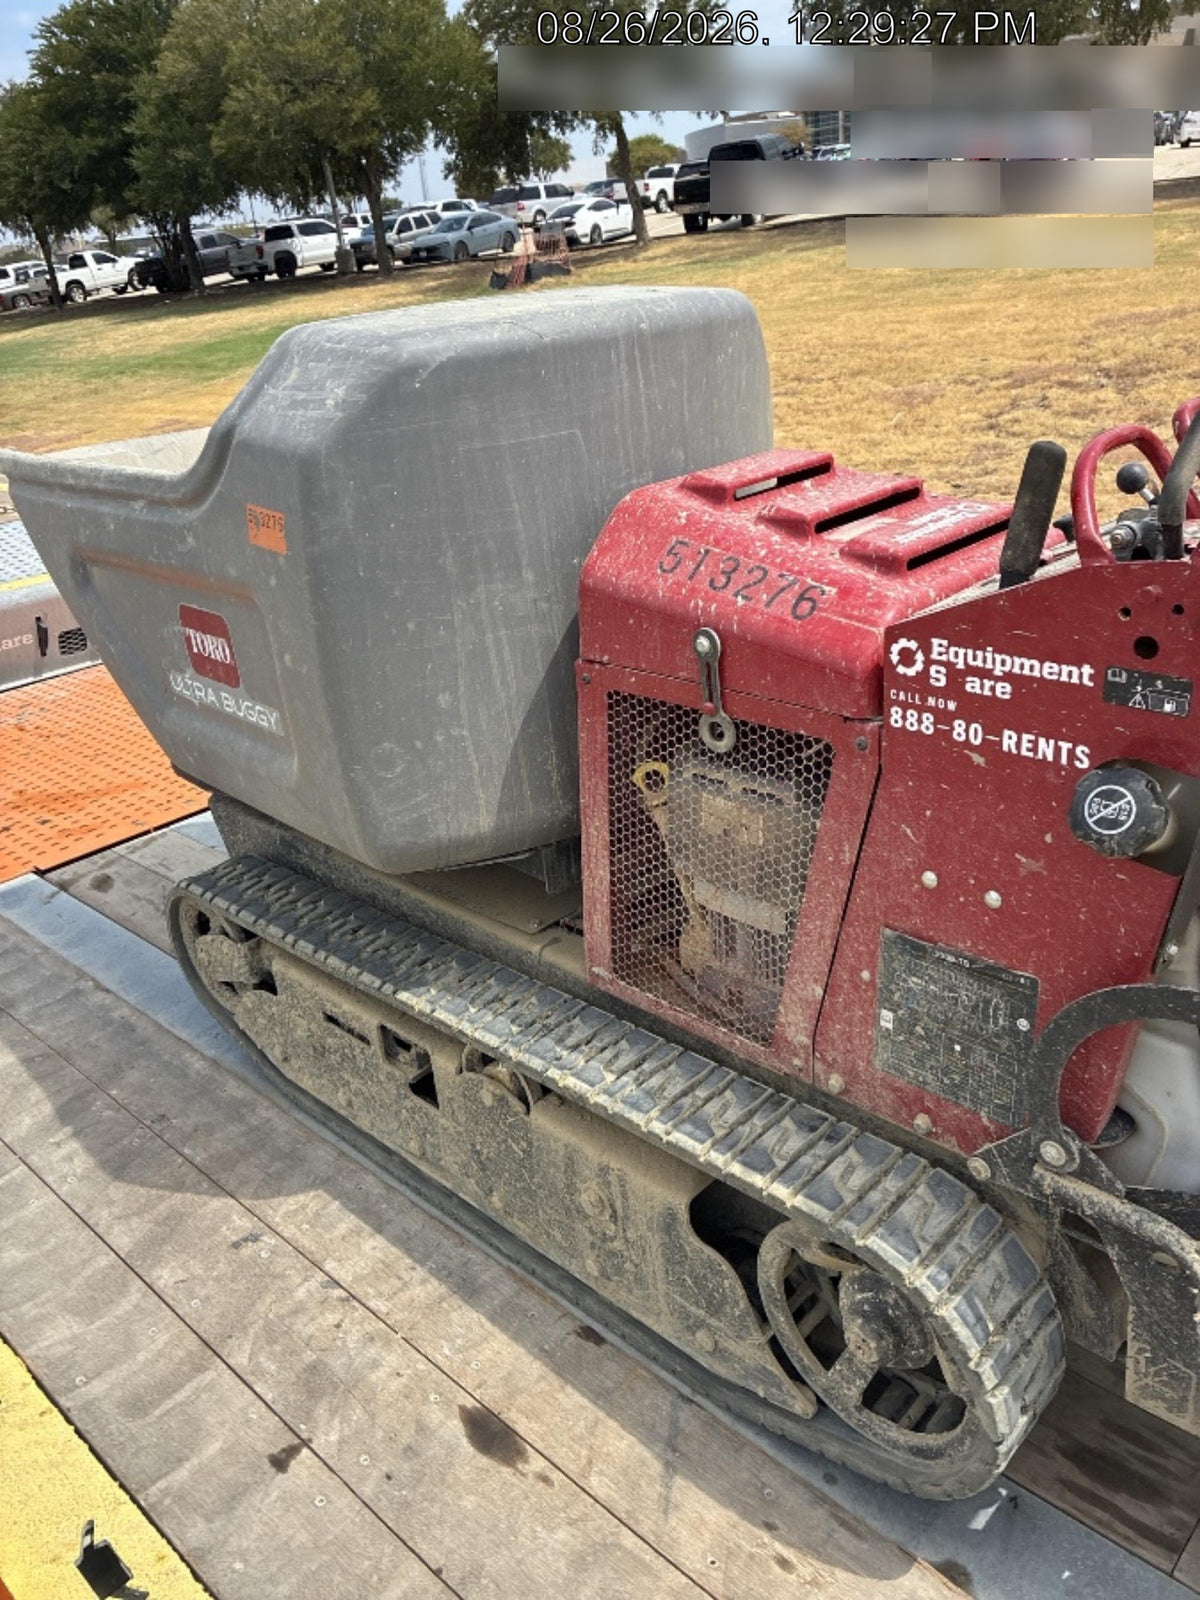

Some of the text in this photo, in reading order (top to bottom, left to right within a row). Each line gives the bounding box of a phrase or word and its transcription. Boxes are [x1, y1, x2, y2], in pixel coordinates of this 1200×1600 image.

[658, 539, 826, 621] 513276
[0, 633, 34, 652] are
[186, 627, 231, 664] TORO
[930, 637, 1095, 687] Equipment
[889, 689, 958, 712] CALL NOW
[889, 706, 1091, 769] 888-80-RENTS
